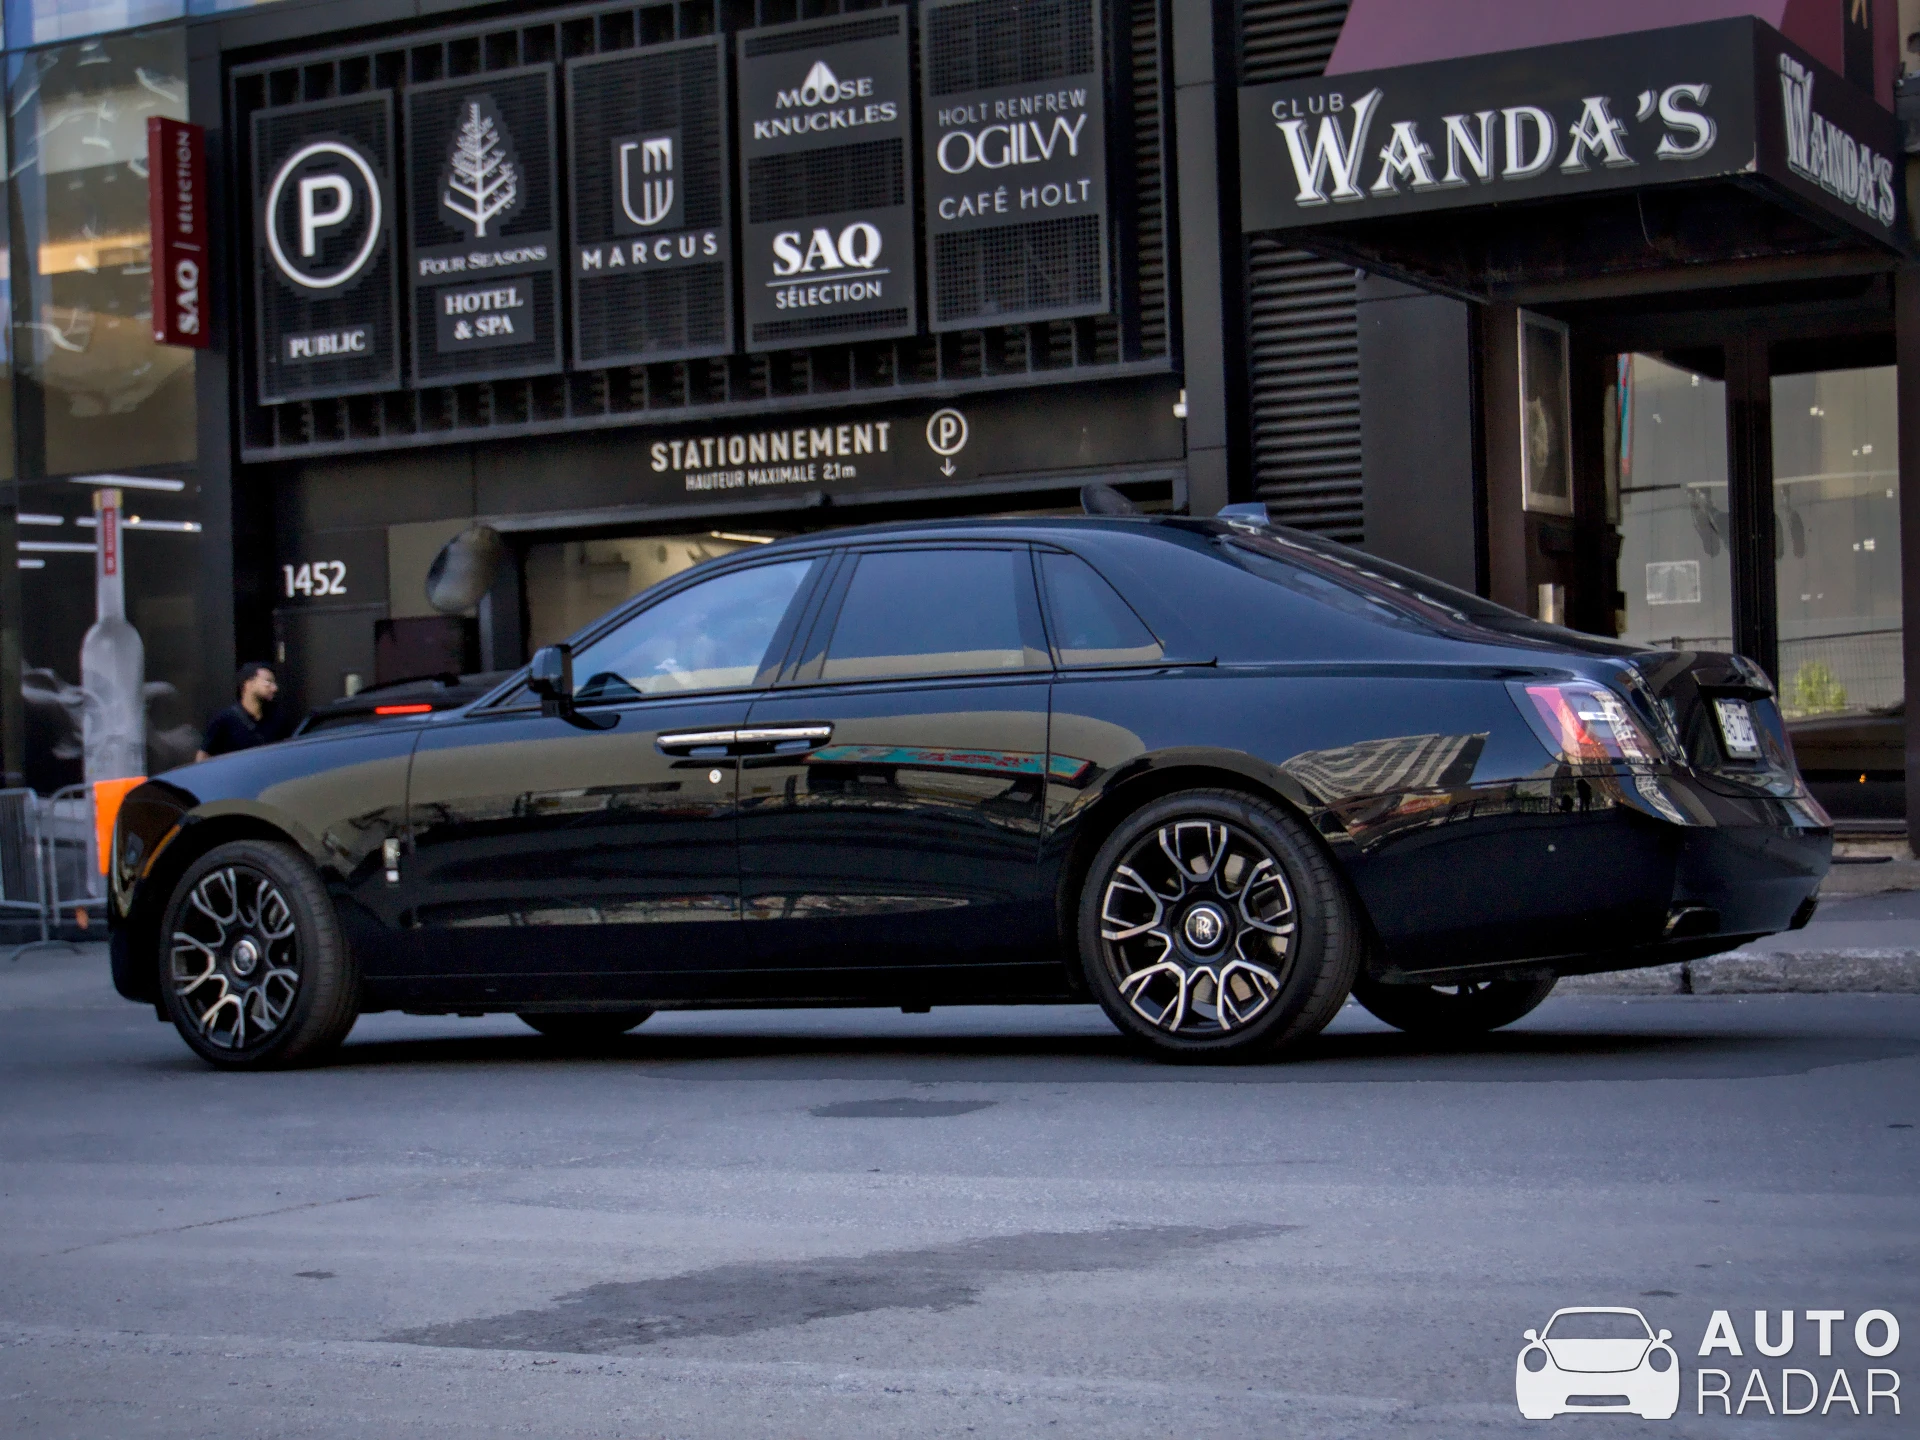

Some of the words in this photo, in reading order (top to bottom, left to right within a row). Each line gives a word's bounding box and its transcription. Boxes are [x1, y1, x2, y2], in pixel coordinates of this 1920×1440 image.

[775, 76, 874, 110] MOOSE
[938, 103, 988, 127] HOLT
[995, 88, 1087, 119] RENFREW
[1271, 93, 1344, 120] CLUB
[753, 102, 898, 140] KNUCKLES
[936, 113, 1088, 175] OGILVY
[1274, 84, 1717, 208] WANDA'S
[1779, 70, 1895, 227] WANDA'S
[301, 174, 353, 258] P
[938, 186, 1010, 220] CAFÉ
[1020, 178, 1091, 210] HOLT
[419, 256, 467, 277] FOUR
[467, 245, 548, 270] SEASONS
[582, 231, 718, 270] MARCUS
[772, 222, 882, 276] SAQ
[175, 258, 201, 336] SAQ
[444, 286, 524, 316] HOTEL
[775, 281, 882, 309] SÉLECTION
[289, 330, 366, 360] PUBLIC
[454, 319, 473, 341] &
[475, 313, 515, 338] SPA
[650, 421, 891, 473] STATIONNEMENT
[939, 417, 958, 449] P
[685, 469, 745, 491] HAUTEUR
[747, 462, 817, 486] MAXIMALE
[282, 560, 348, 598] 1452
